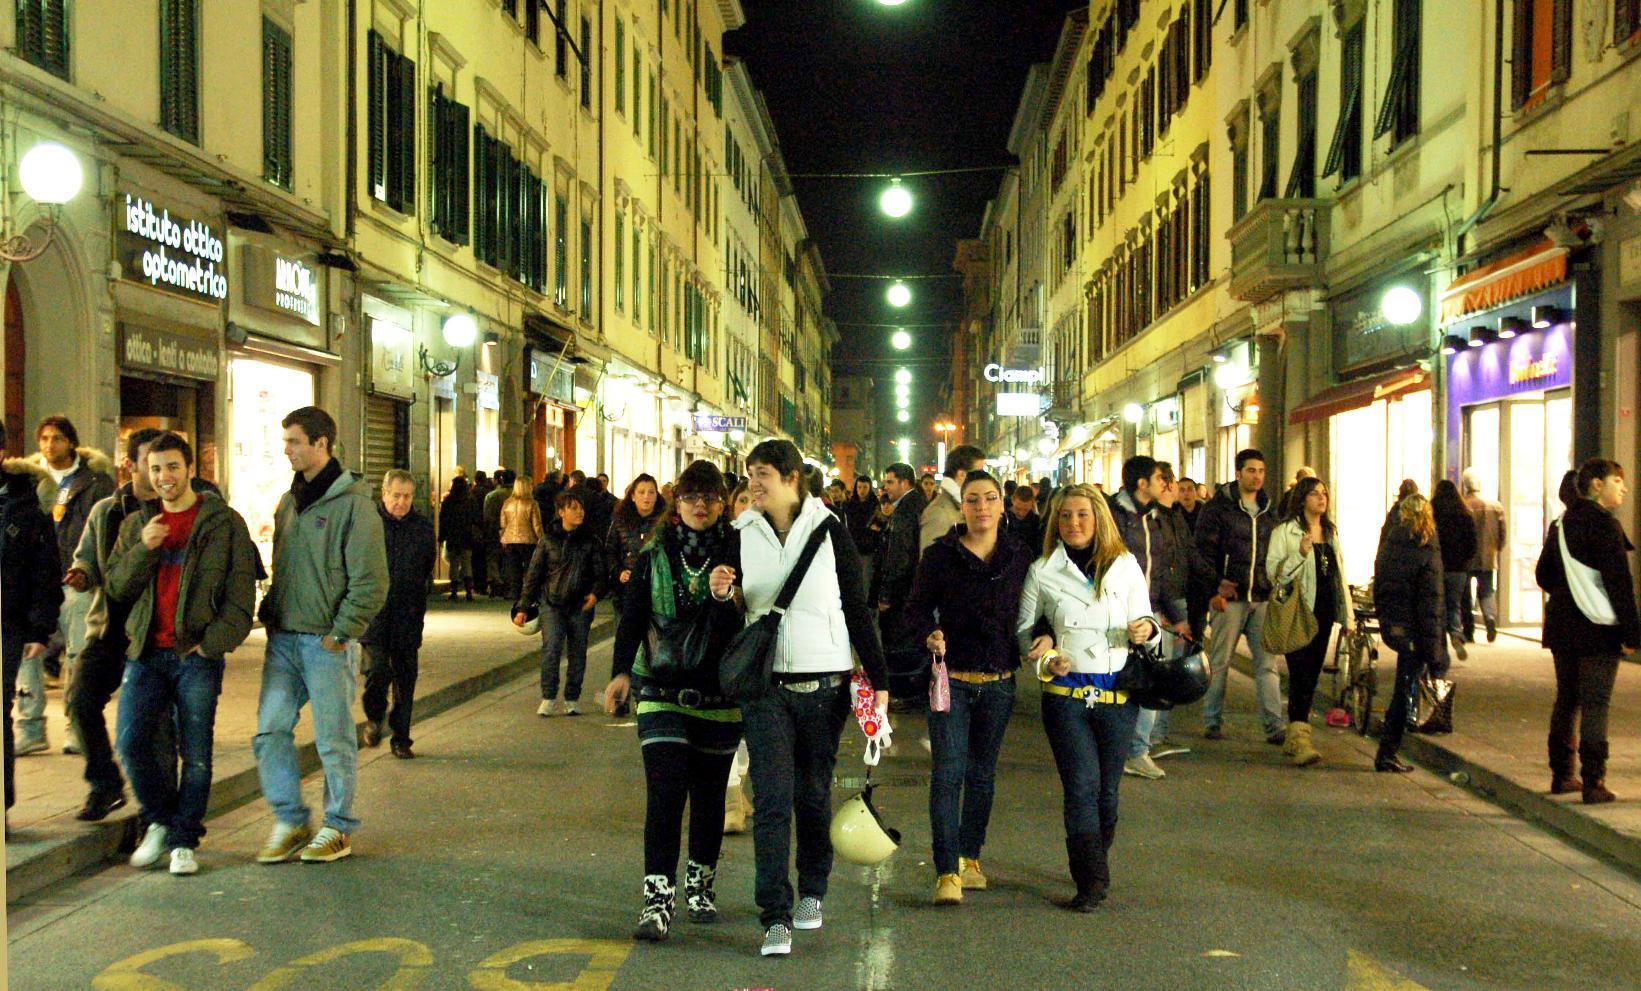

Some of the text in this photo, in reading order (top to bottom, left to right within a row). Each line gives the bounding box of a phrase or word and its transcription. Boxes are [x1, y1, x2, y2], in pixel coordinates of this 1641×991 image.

[126, 193, 223, 263] istituto ottico
[142, 244, 228, 299] optometrico
